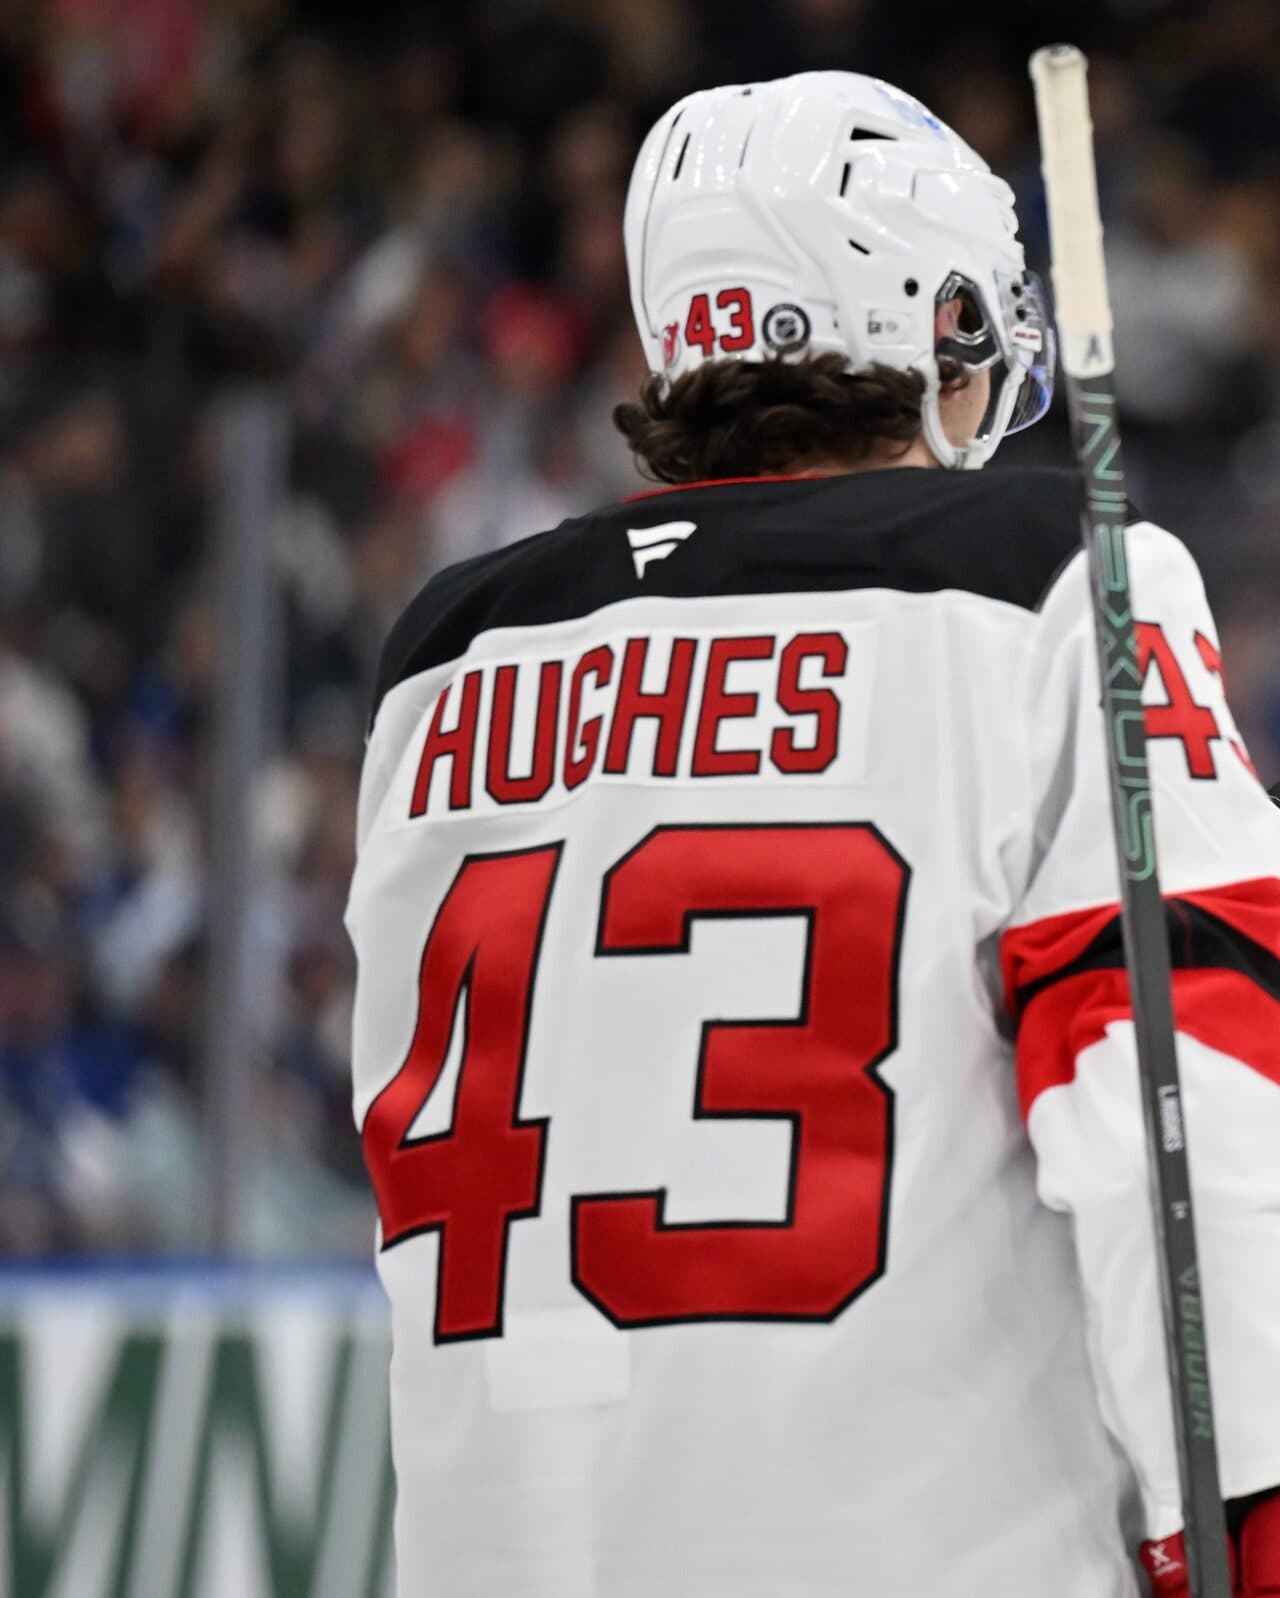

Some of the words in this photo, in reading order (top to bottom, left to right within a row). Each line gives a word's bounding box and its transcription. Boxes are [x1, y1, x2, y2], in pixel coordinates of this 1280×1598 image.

[684, 287, 753, 356] 43
[409, 631, 849, 819] HUGHES
[362, 821, 912, 1346] 43
